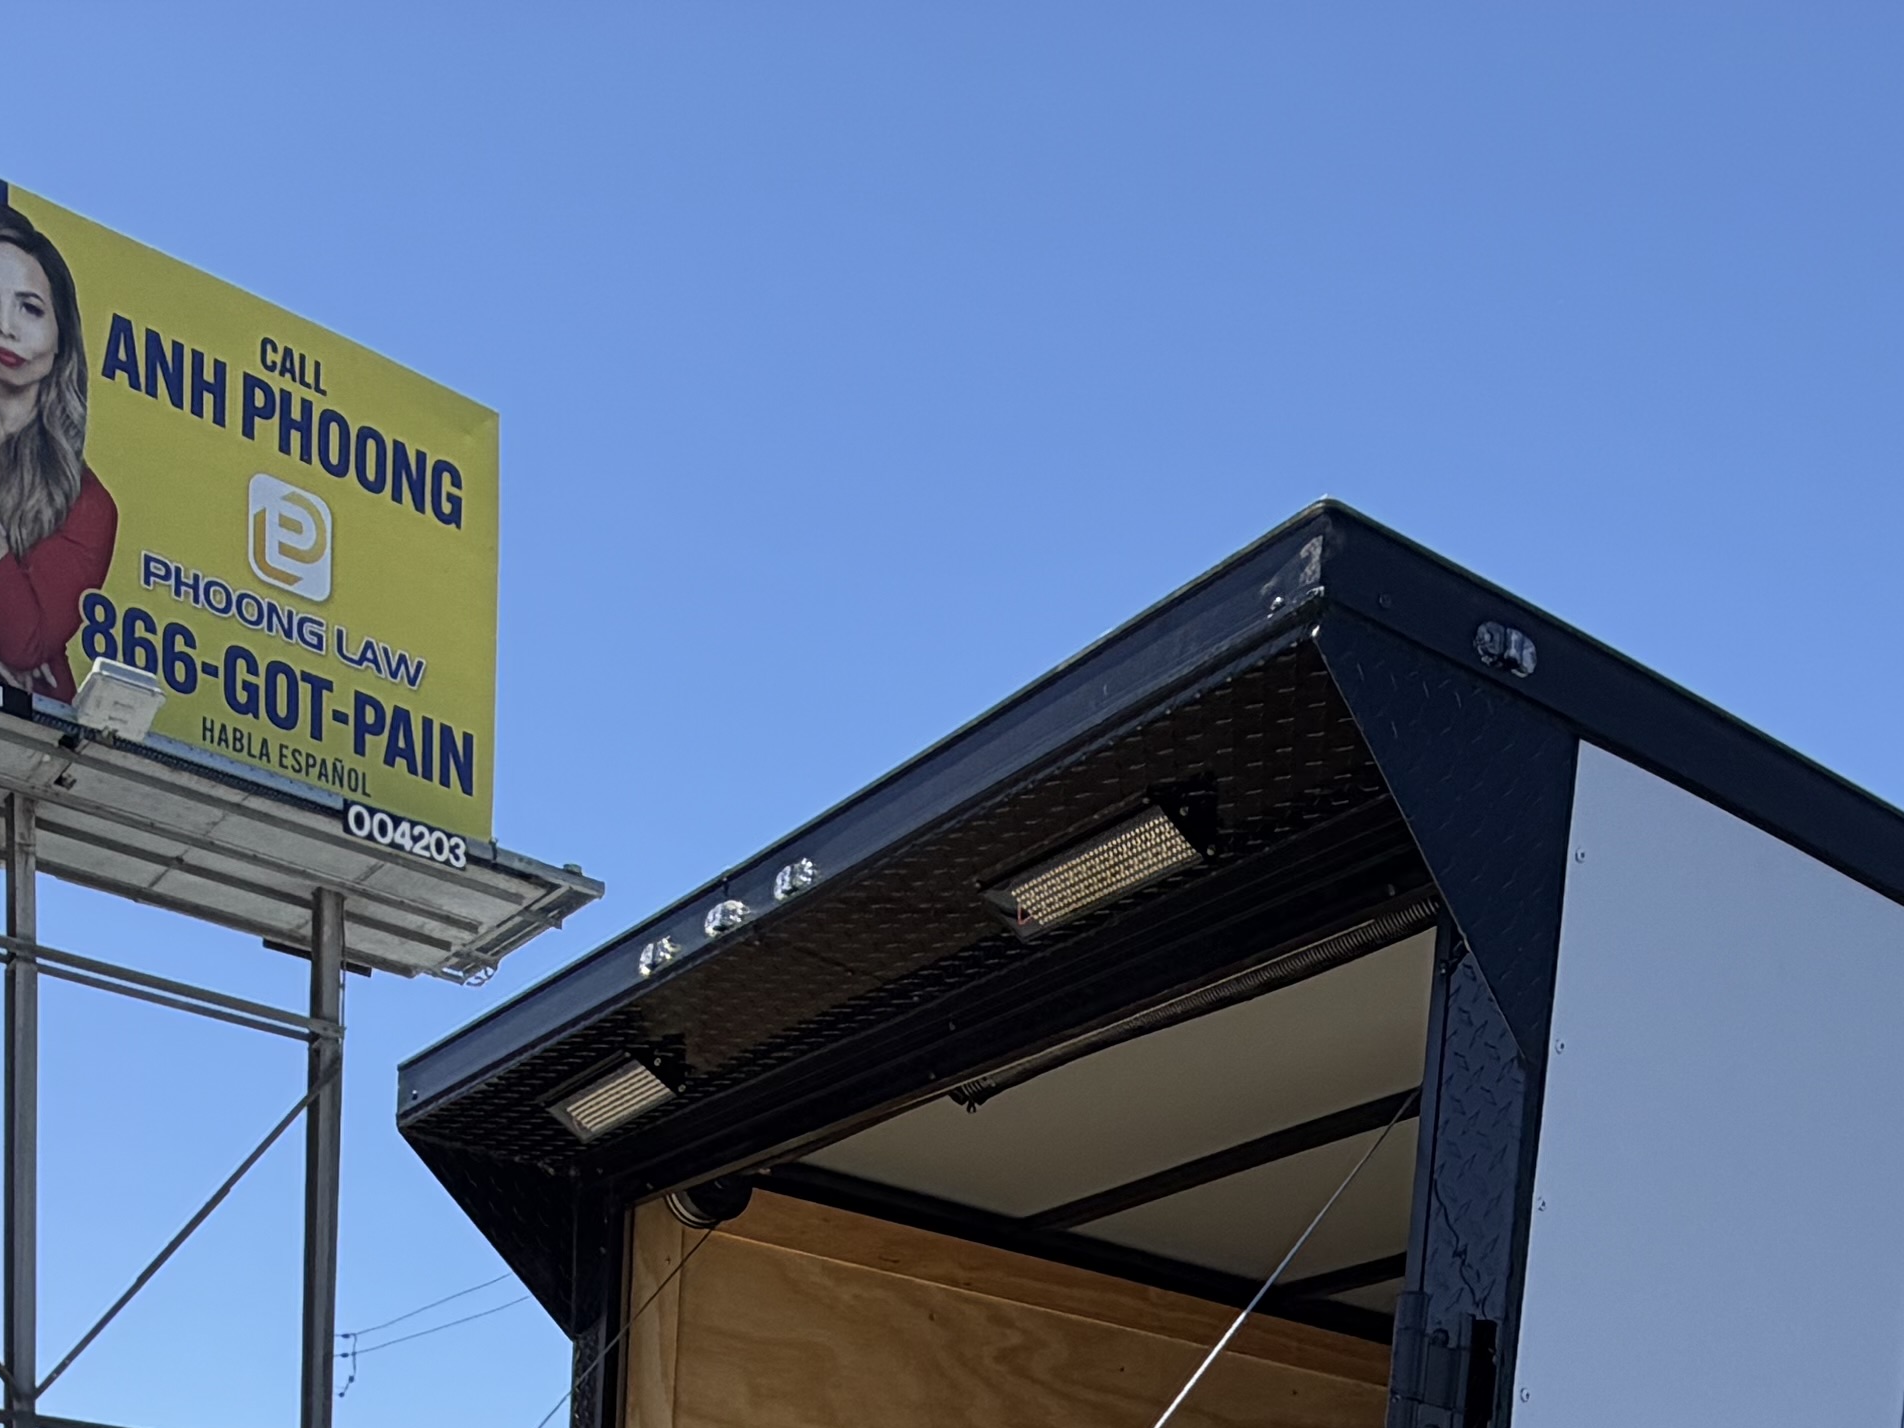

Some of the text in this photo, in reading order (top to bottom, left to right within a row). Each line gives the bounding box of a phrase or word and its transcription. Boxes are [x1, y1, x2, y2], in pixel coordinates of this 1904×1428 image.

[102, 312, 463, 530] ANH PHOONG
[259, 337, 327, 396] CALL
[142, 551, 425, 689] PHOONG LAW
[80, 591, 475, 797] 866-GOT-PAIN
[202, 717, 371, 798] HABLA ESPAÑOL
[347, 809, 467, 868] 004203
